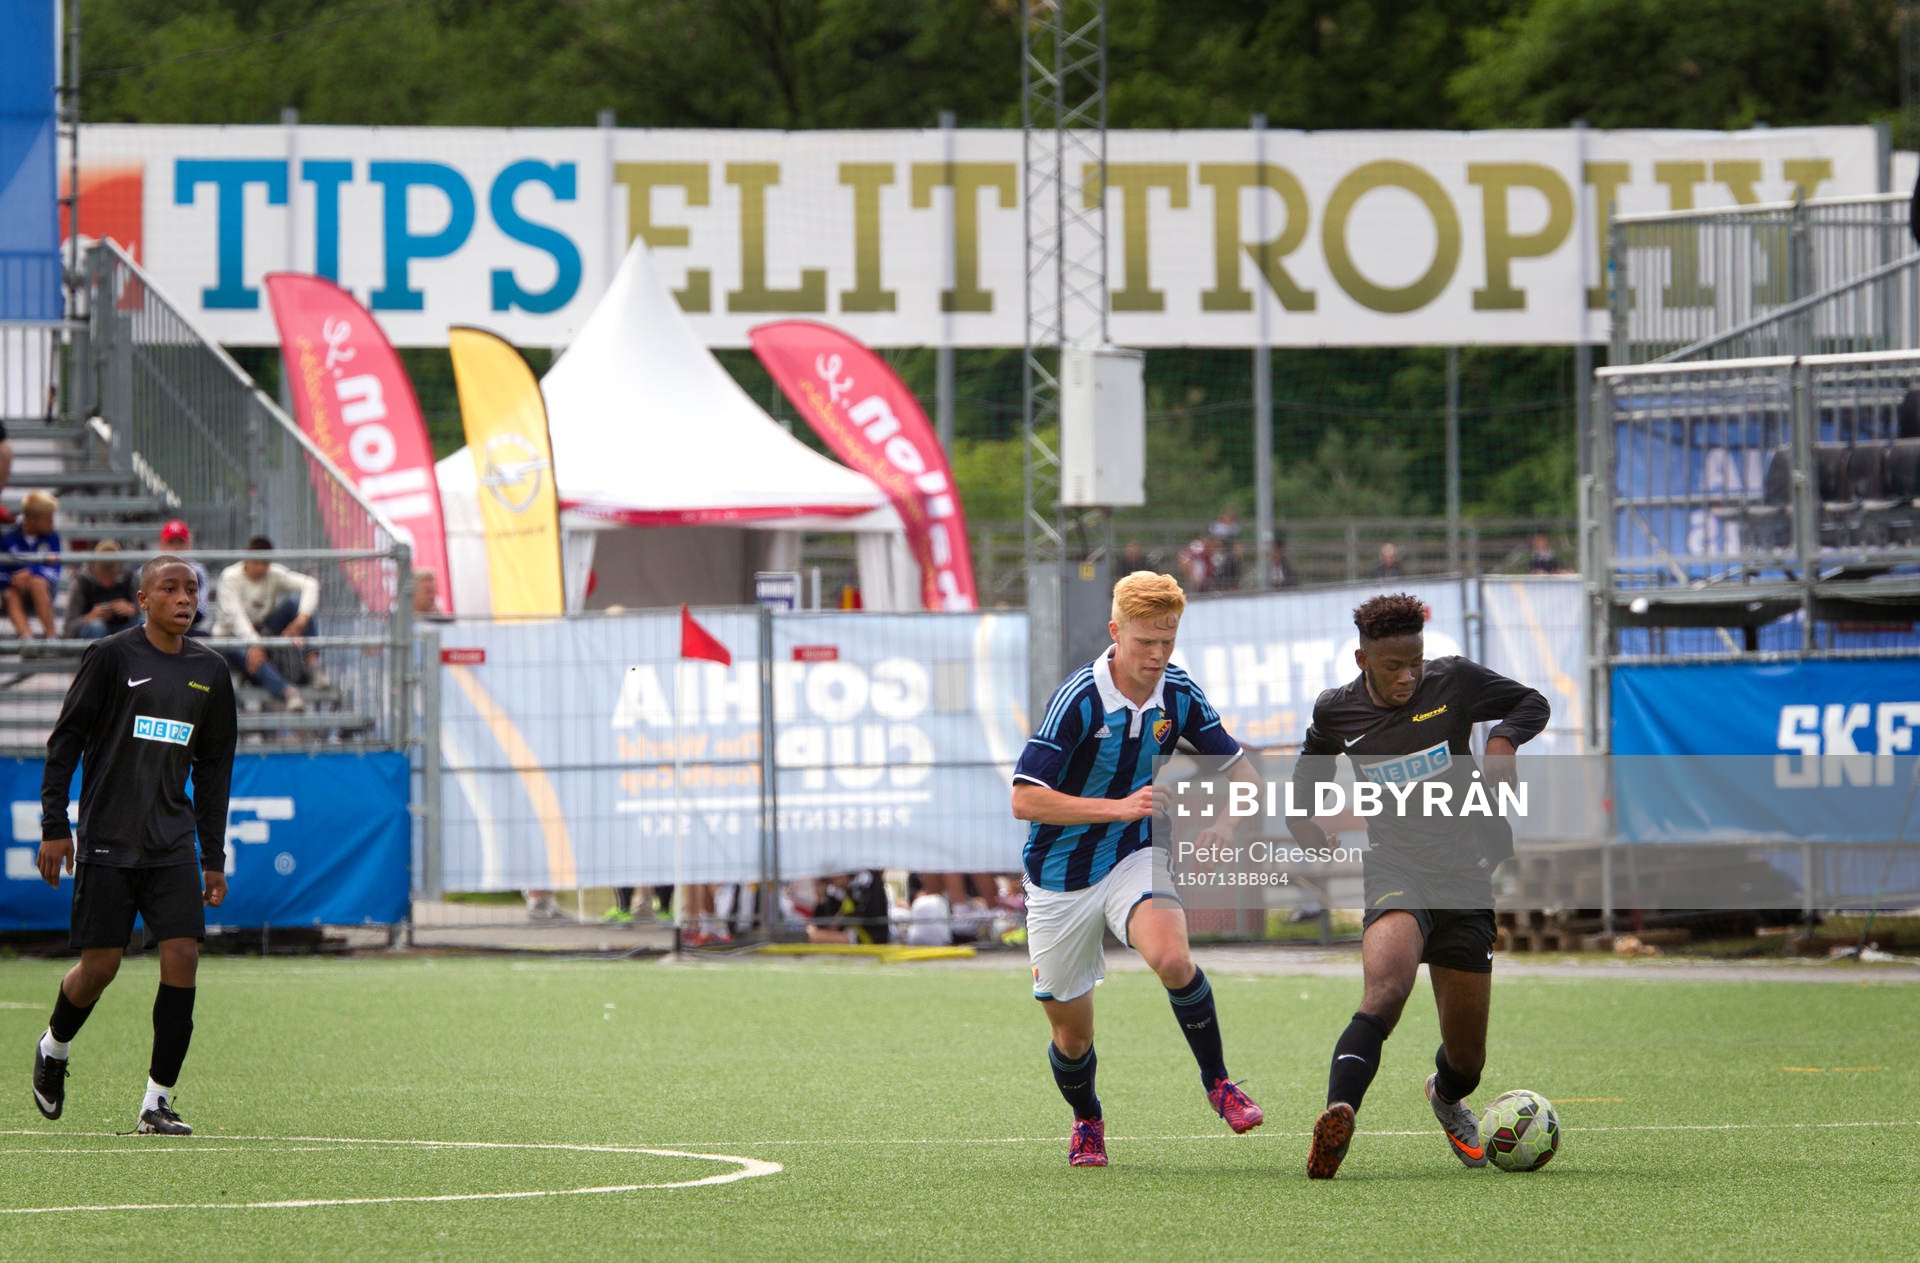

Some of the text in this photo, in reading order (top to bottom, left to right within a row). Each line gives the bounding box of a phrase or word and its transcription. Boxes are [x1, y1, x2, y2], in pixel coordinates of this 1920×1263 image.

[174, 158, 583, 314] TIPS
[137, 719, 190, 741] MEPC
[1364, 750, 1446, 785] MEPC
[1773, 702, 1920, 789] SKF
[5, 797, 295, 880] SF
